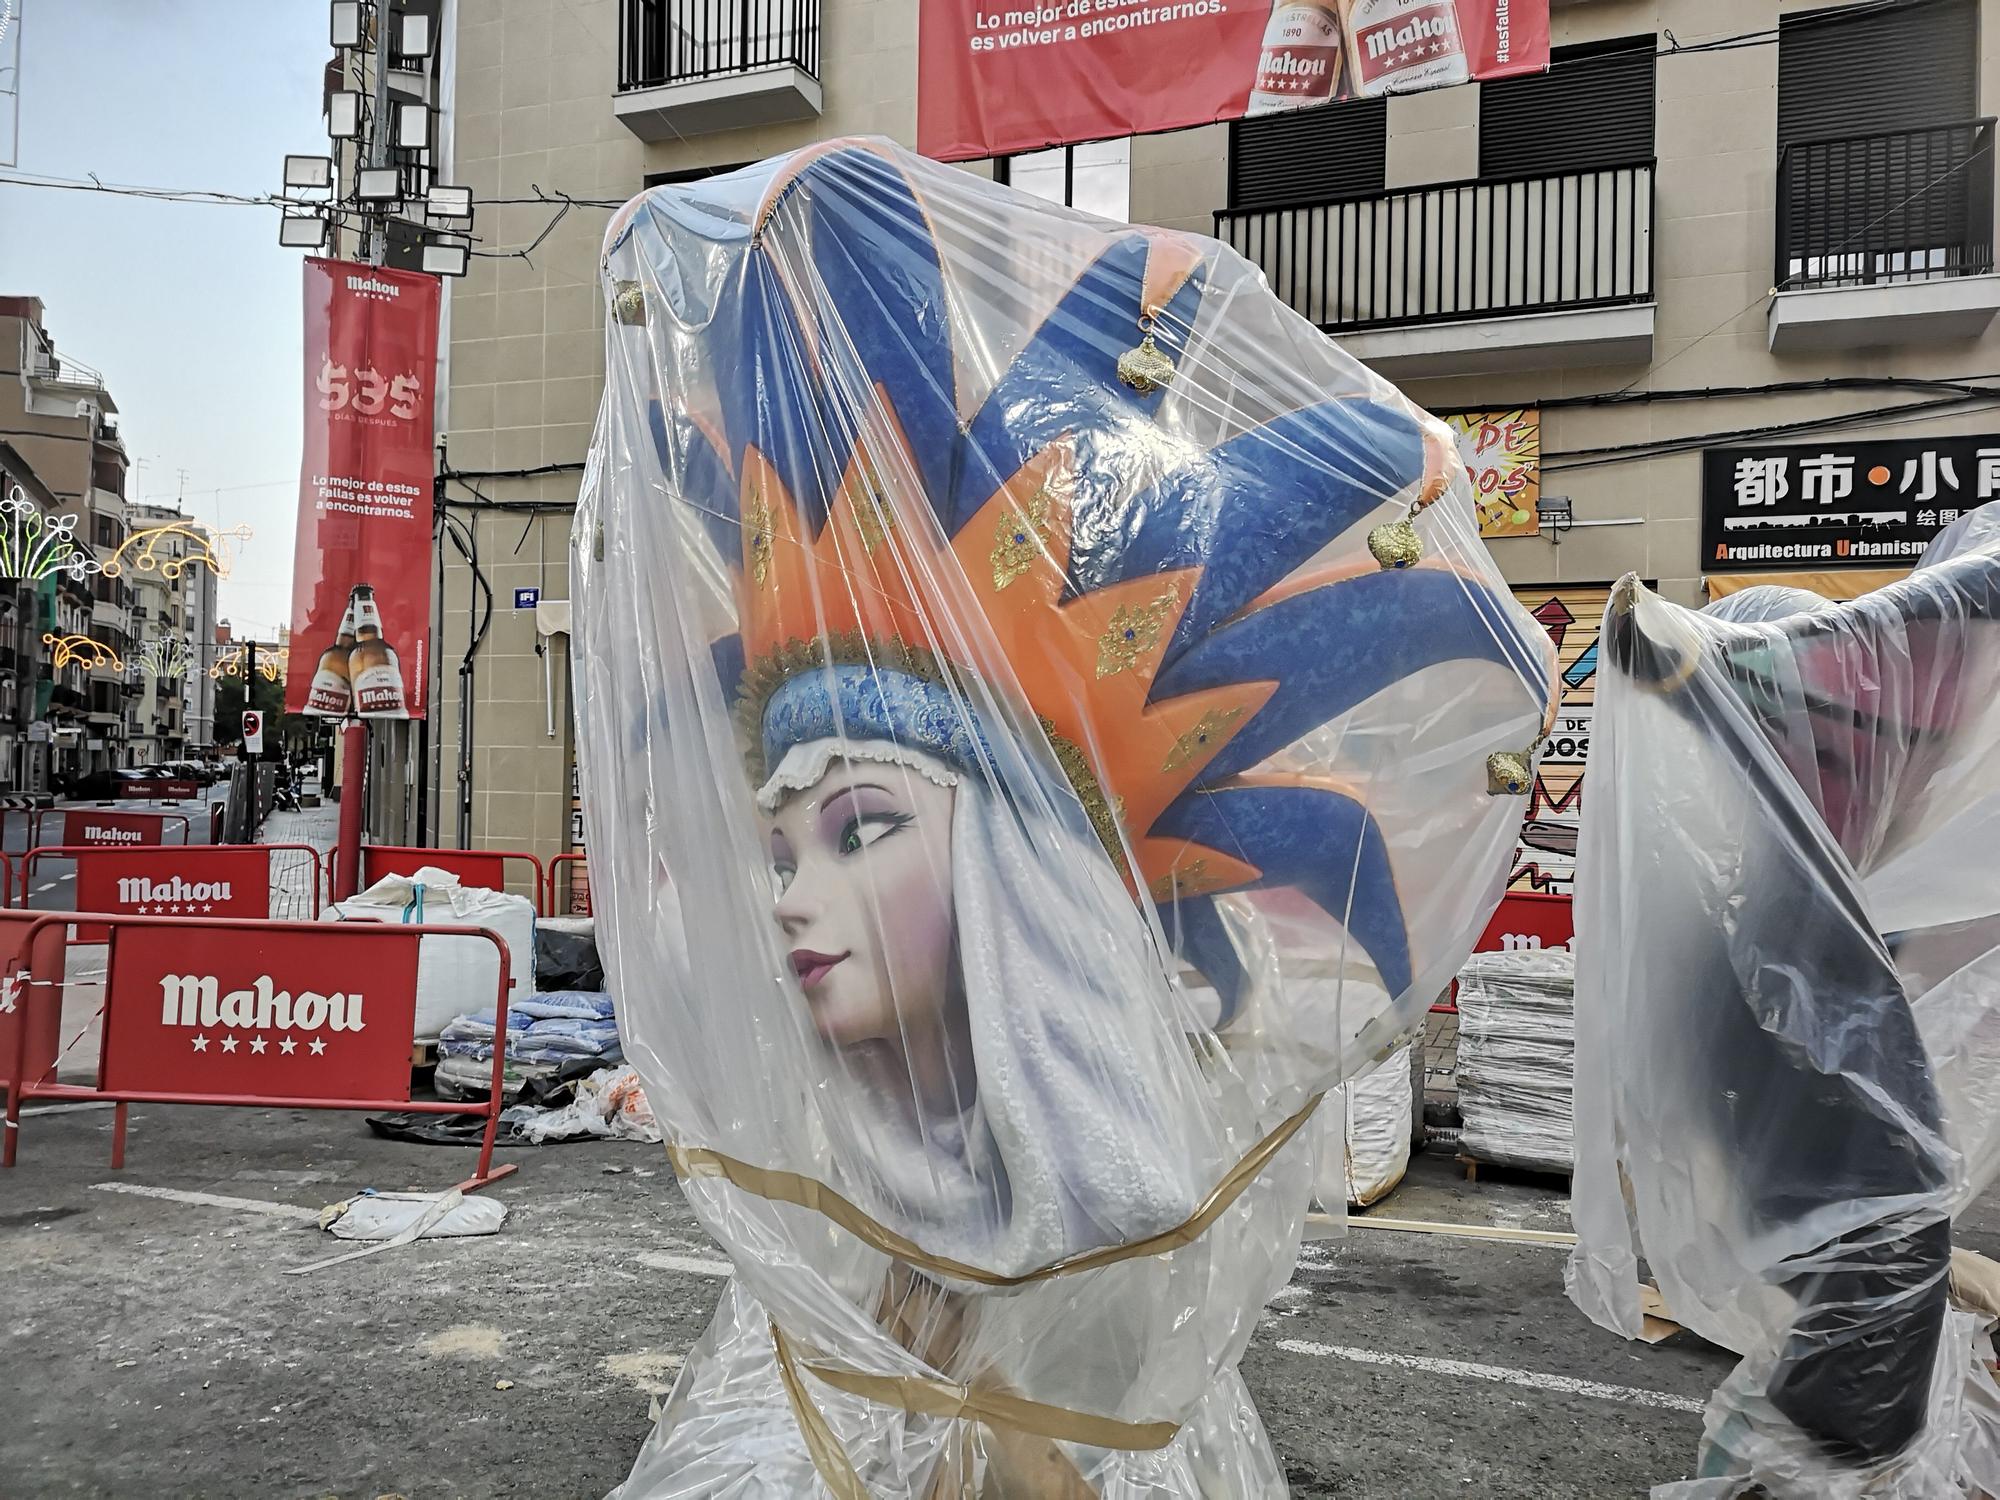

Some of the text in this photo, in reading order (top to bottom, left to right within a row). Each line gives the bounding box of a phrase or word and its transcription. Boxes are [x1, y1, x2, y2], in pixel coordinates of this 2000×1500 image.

[970, 35, 995, 50] es
[998, 28, 1060, 48] volver
[1064, 25, 1076, 41] a
[1080, 0, 1227, 38] encontrarnos.
[976, 12, 1000, 30] Lo
[1005, 3, 1063, 28] mejor
[1066, 0, 1091, 18] de
[1282, 28, 1302, 37] 1890
[347, 276, 399, 297] Mahou
[316, 358, 422, 420] 535
[1475, 421, 1527, 455] DE
[313, 475, 420, 496] Lo mejor de estas
[319, 487, 413, 507] Fallas es volver
[316, 500, 414, 519] a encontrarnos.
[1916, 509, 1978, 526] 绘图
[1716, 543, 1832, 560] Arquitectura
[1565, 719, 1587, 731] DE
[84, 826, 142, 841] Mahou
[117, 875, 232, 903] Mahou
[159, 973, 366, 1033] Mahou
